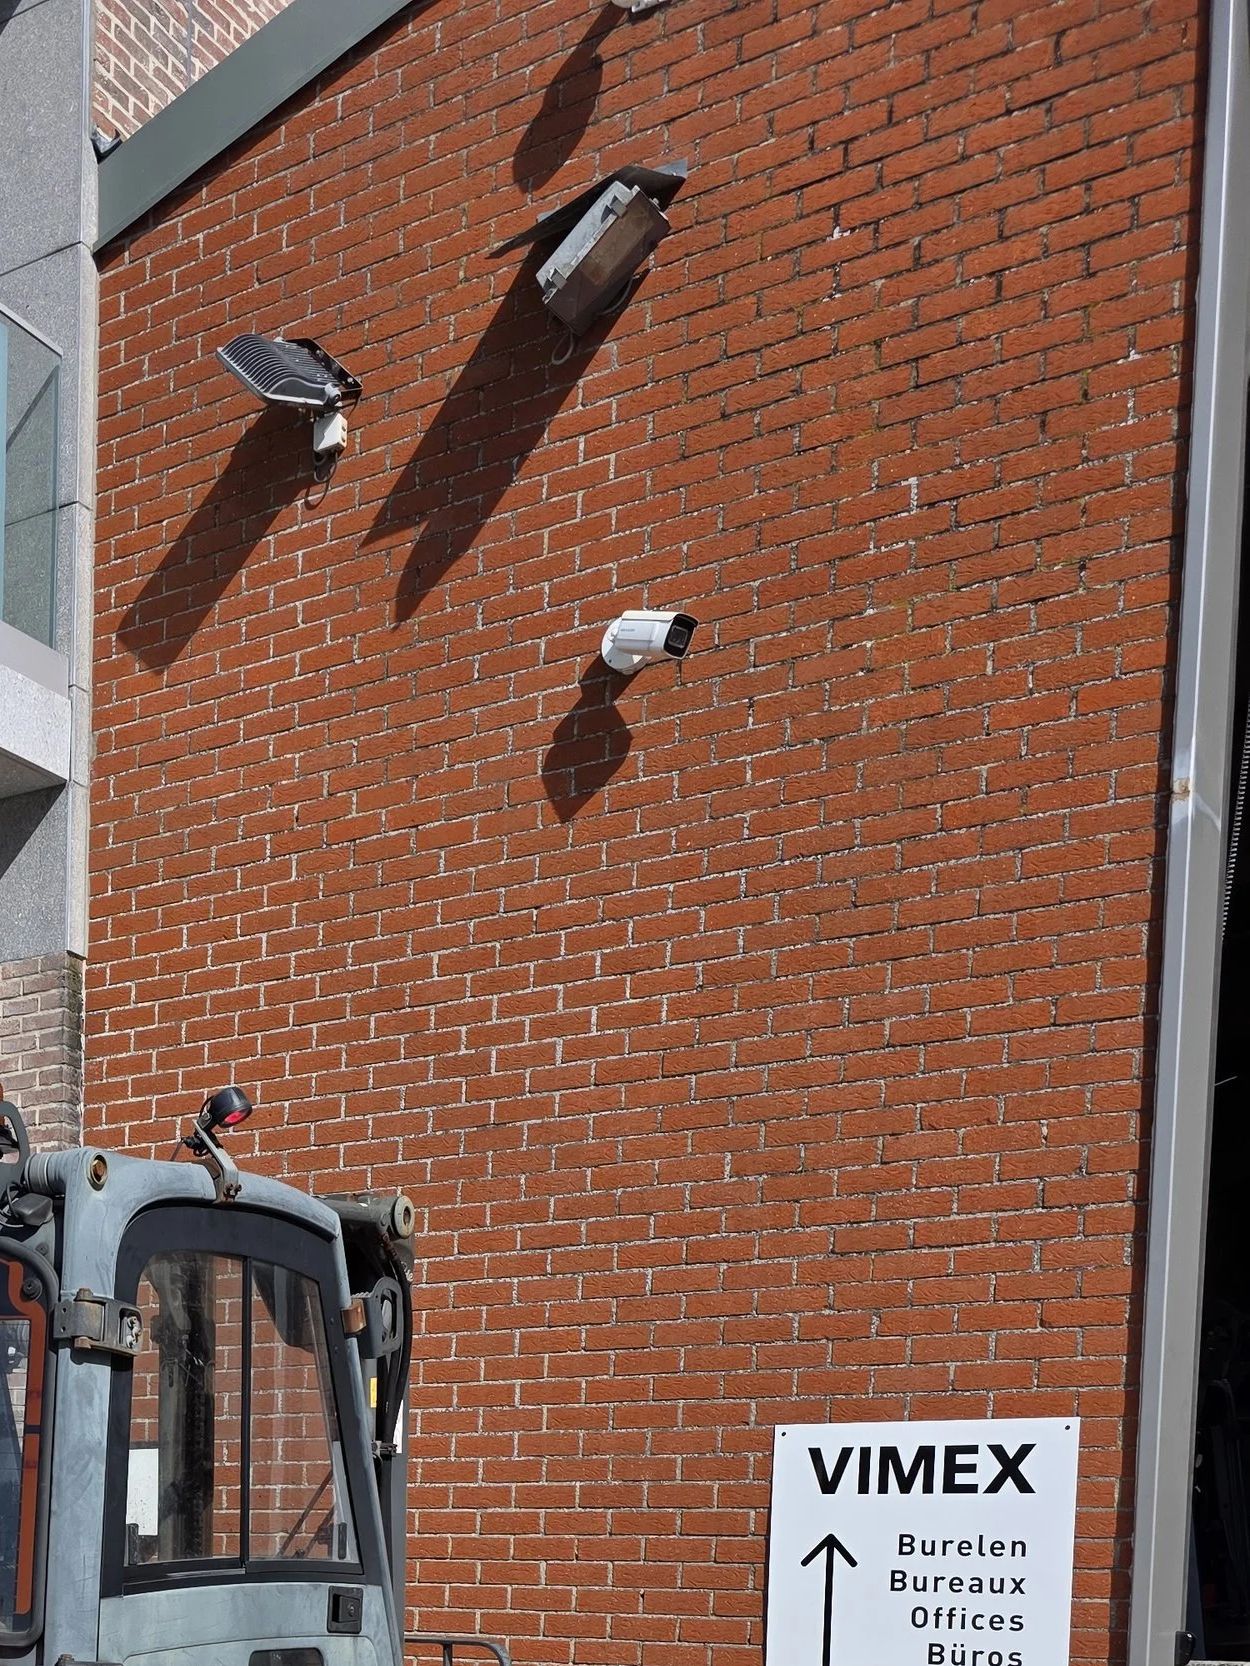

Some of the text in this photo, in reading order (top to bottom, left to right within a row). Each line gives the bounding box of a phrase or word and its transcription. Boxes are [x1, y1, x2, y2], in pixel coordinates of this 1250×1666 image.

[808, 1443, 1037, 1494] VIMEX
[898, 1533, 1027, 1557] Burelen
[890, 1569, 1026, 1595] Bureaux
[911, 1606, 1024, 1631] Offices
